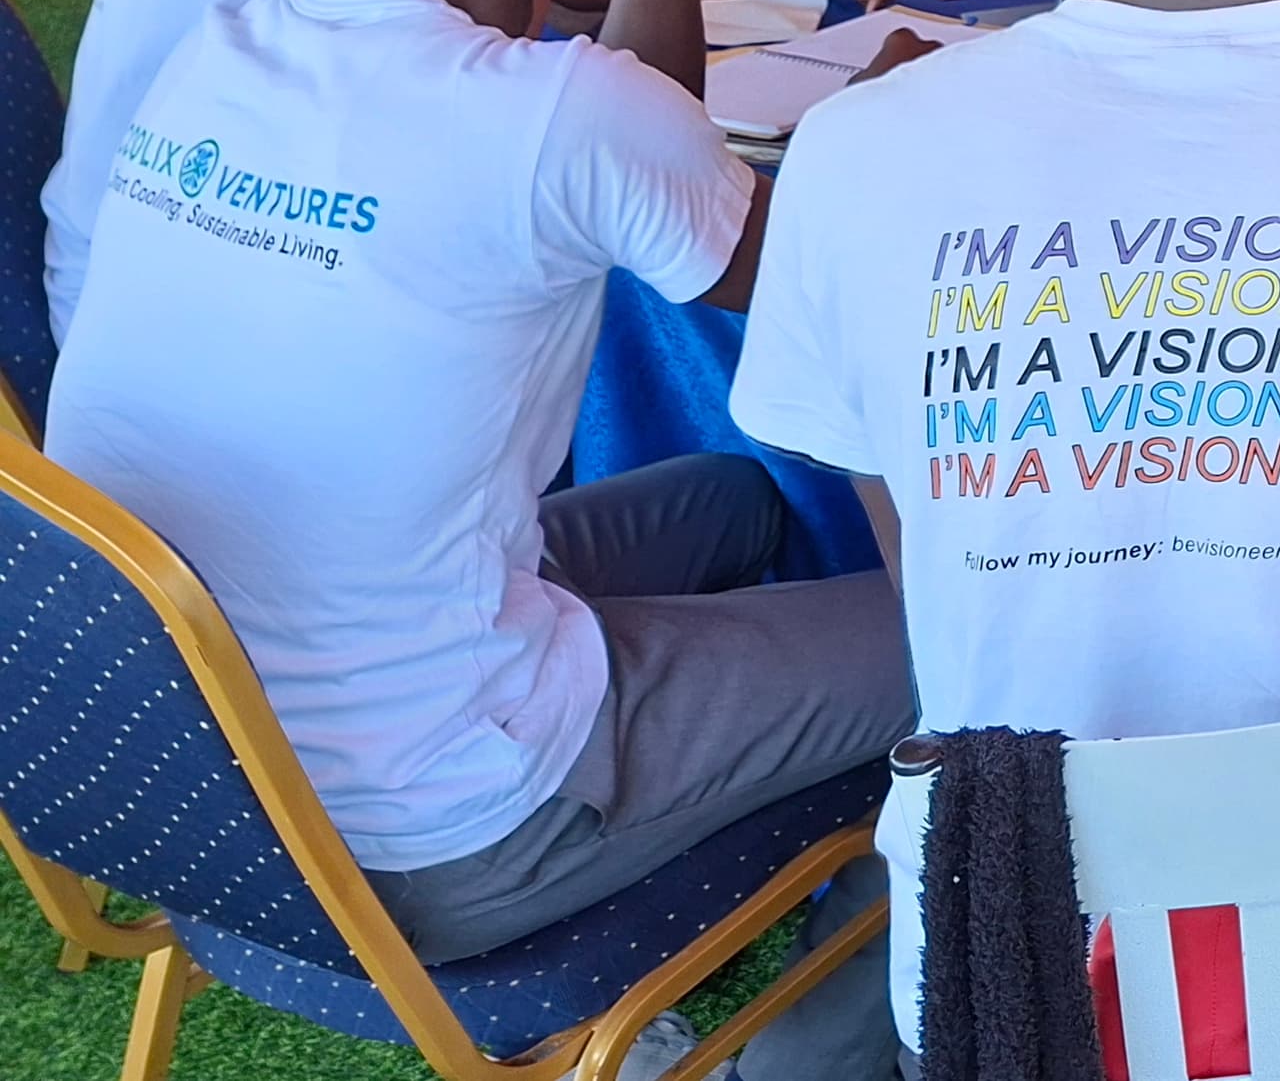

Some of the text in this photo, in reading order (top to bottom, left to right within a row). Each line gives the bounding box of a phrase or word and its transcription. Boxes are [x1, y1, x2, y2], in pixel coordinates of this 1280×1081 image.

[215, 165, 380, 234] VENTURES
[186, 203, 275, 253] Sustainable
[278, 233, 344, 271] Living.
[933, 225, 1020, 281] I'M
[1031, 221, 1078, 270] A
[927, 281, 1009, 338] I'M
[1024, 276, 1070, 325] A
[923, 341, 1001, 397] I'M
[1017, 337, 1062, 385] A
[926, 397, 997, 448] I'M
[1012, 391, 1057, 441] A
[929, 453, 995, 500] I'M
[1004, 447, 1051, 497] A
[965, 550, 1020, 574] Follow
[1027, 547, 1062, 569] my
[1064, 539, 1164, 569] journey:
